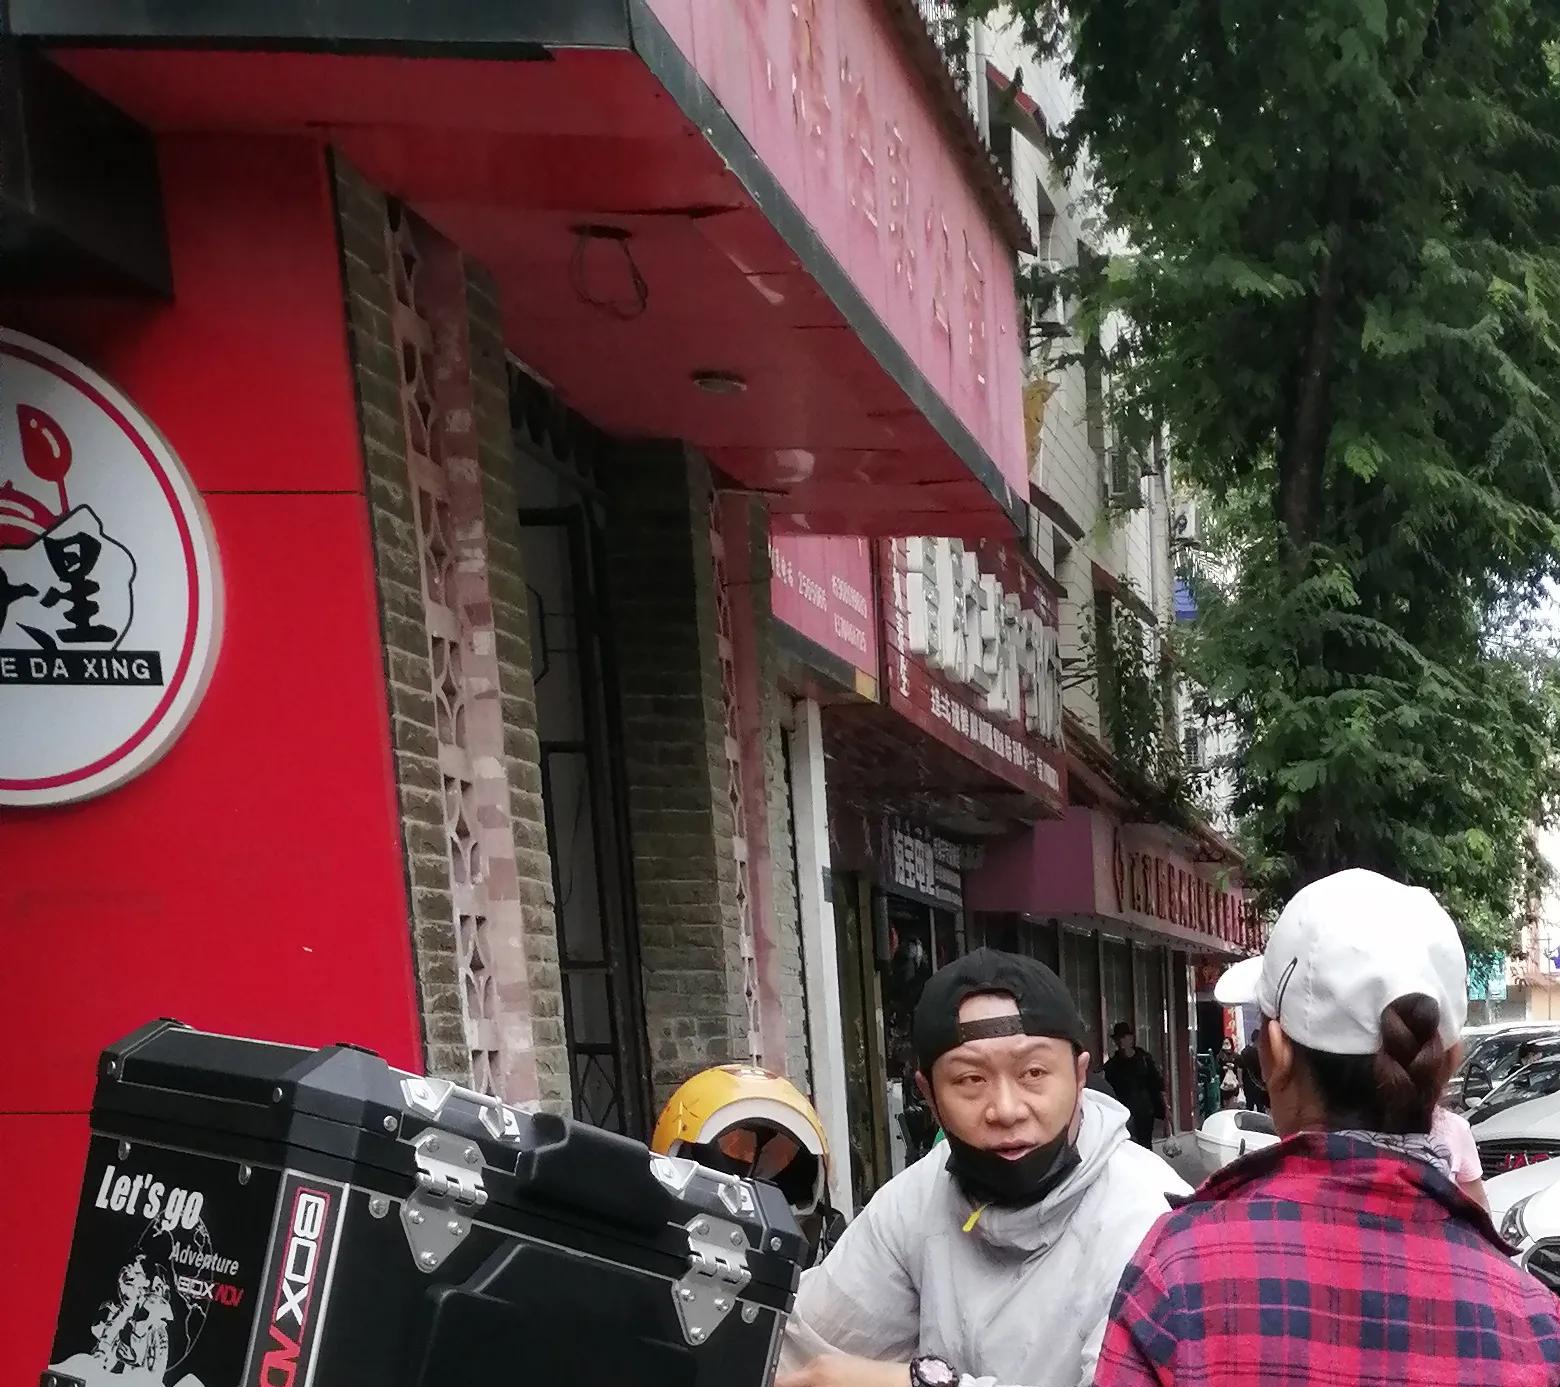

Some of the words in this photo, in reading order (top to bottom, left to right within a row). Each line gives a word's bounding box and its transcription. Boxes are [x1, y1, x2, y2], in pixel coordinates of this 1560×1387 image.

[30, 658, 69, 679] DA
[83, 658, 151, 680] XING
[95, 1164, 165, 1220] Let's
[161, 1186, 204, 1232] go
[169, 1240, 240, 1276] Adventure
[275, 1192, 327, 1326] BOX
